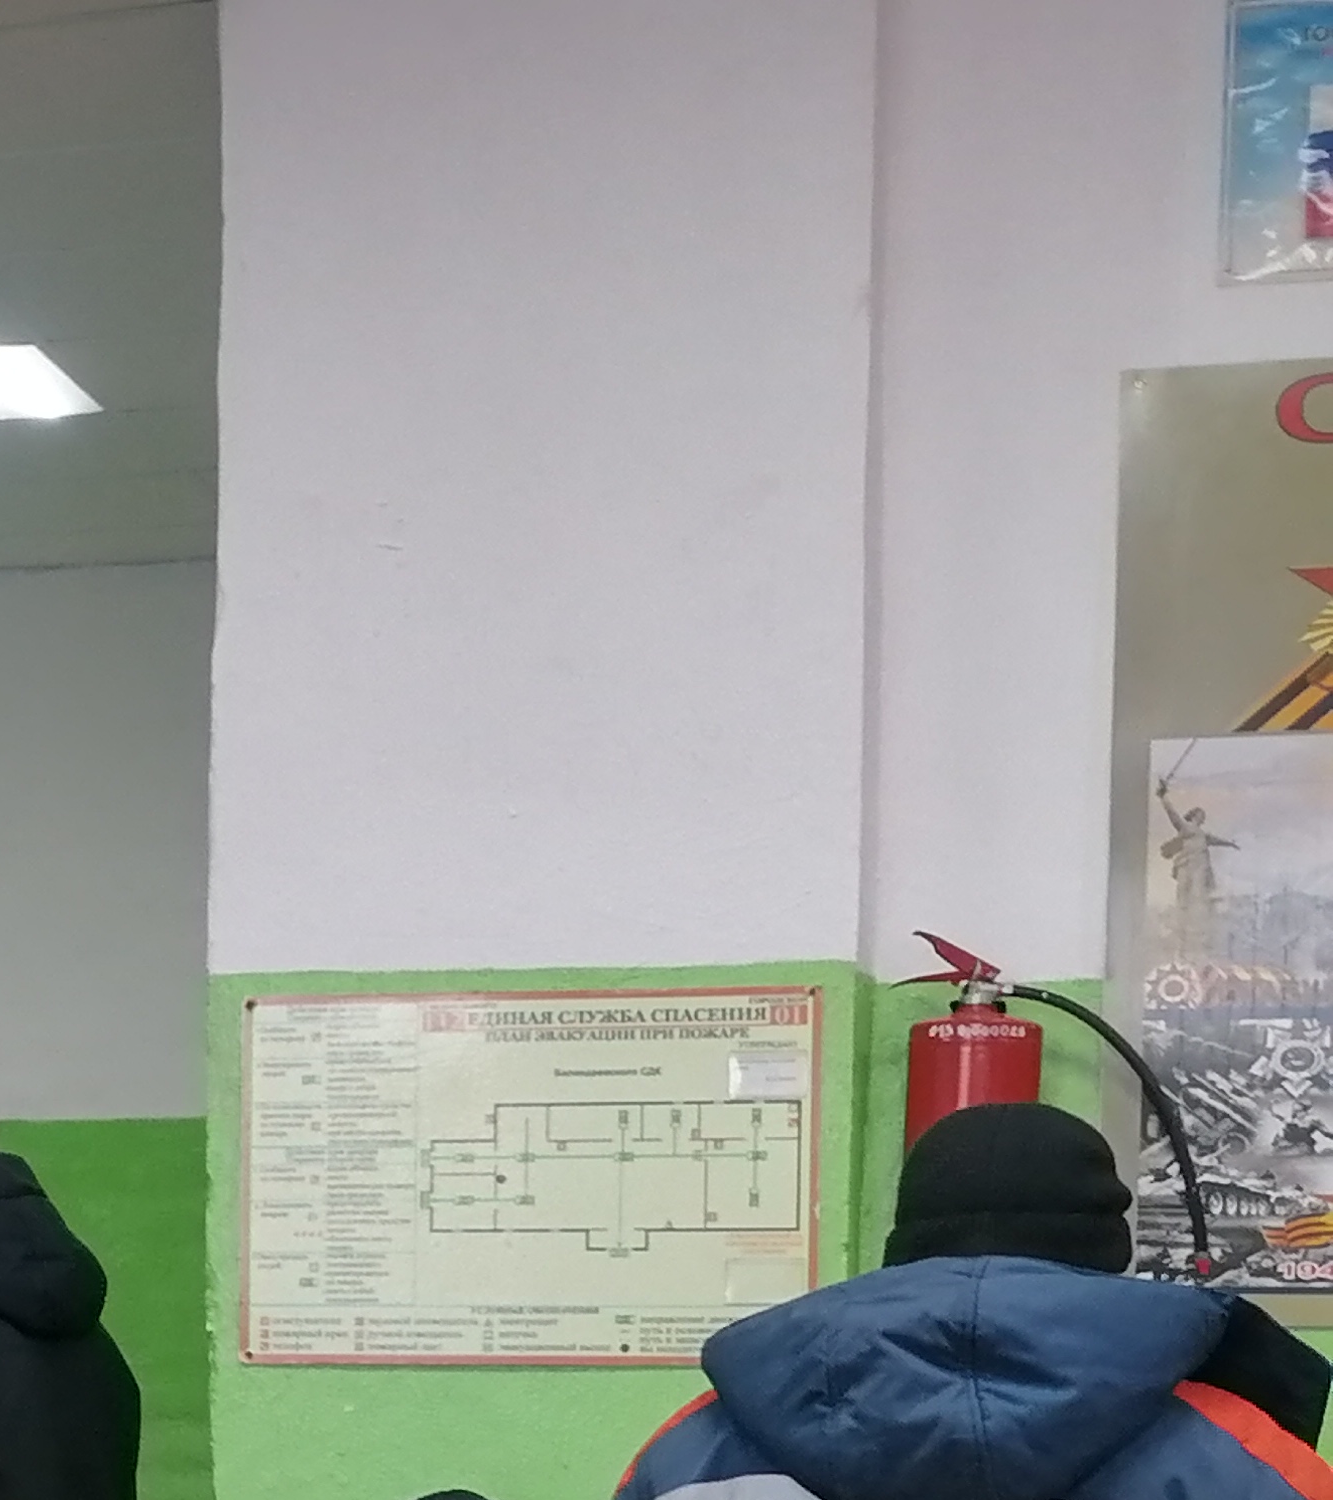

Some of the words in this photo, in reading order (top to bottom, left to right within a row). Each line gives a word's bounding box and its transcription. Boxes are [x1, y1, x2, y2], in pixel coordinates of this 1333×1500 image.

[468, 1010, 553, 1027] ЕДИНАЯ
[557, 1008, 646, 1025] СЛУЖБА
[650, 1006, 767, 1023] СПАСЕНИЯ
[774, 1004, 801, 1026] 01
[534, 1028, 635, 1043] ЭВАКУАЦИИ
[639, 1027, 674, 1041] ПРИ
[679, 1026, 750, 1040] ПОЖАРЕ
